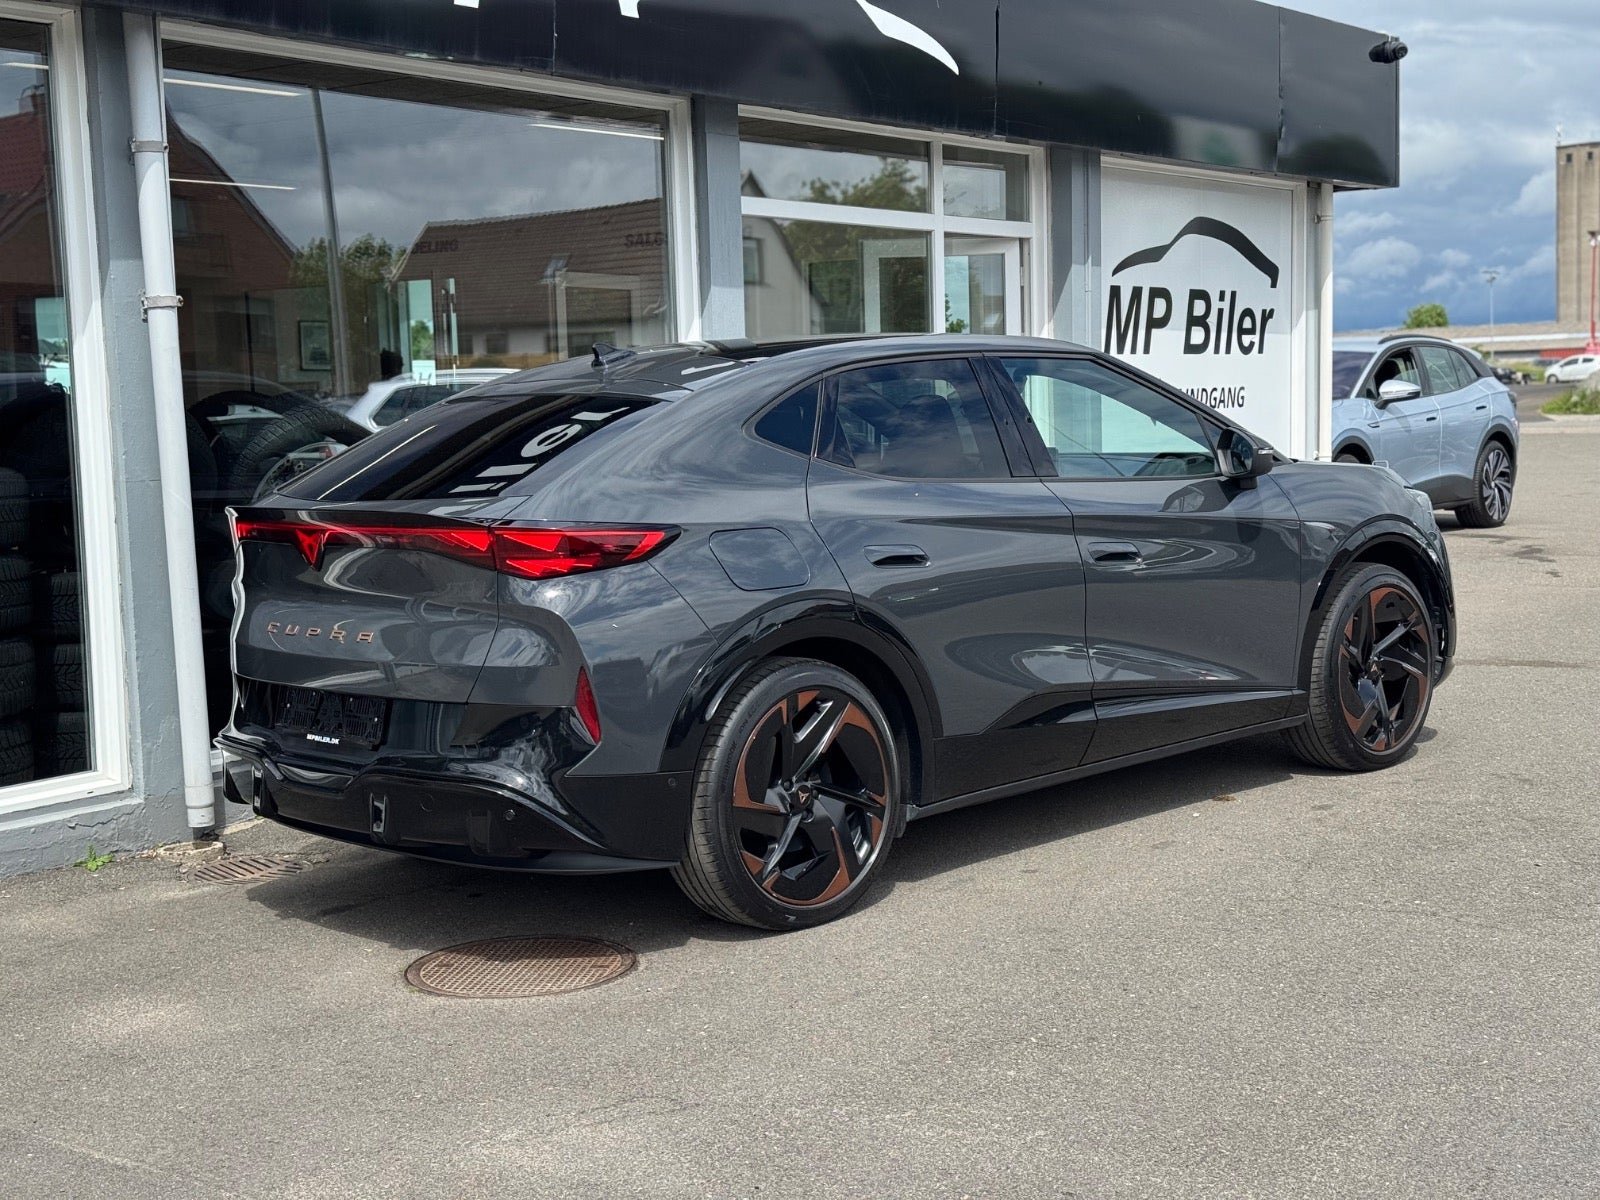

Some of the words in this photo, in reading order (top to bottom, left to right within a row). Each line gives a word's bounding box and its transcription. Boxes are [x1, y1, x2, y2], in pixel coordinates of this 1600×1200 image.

[1103, 285, 1173, 355] MP
[1182, 288, 1275, 356] Biler
[1184, 386, 1245, 409] NDGANG
[266, 621, 375, 644] CUPRA
